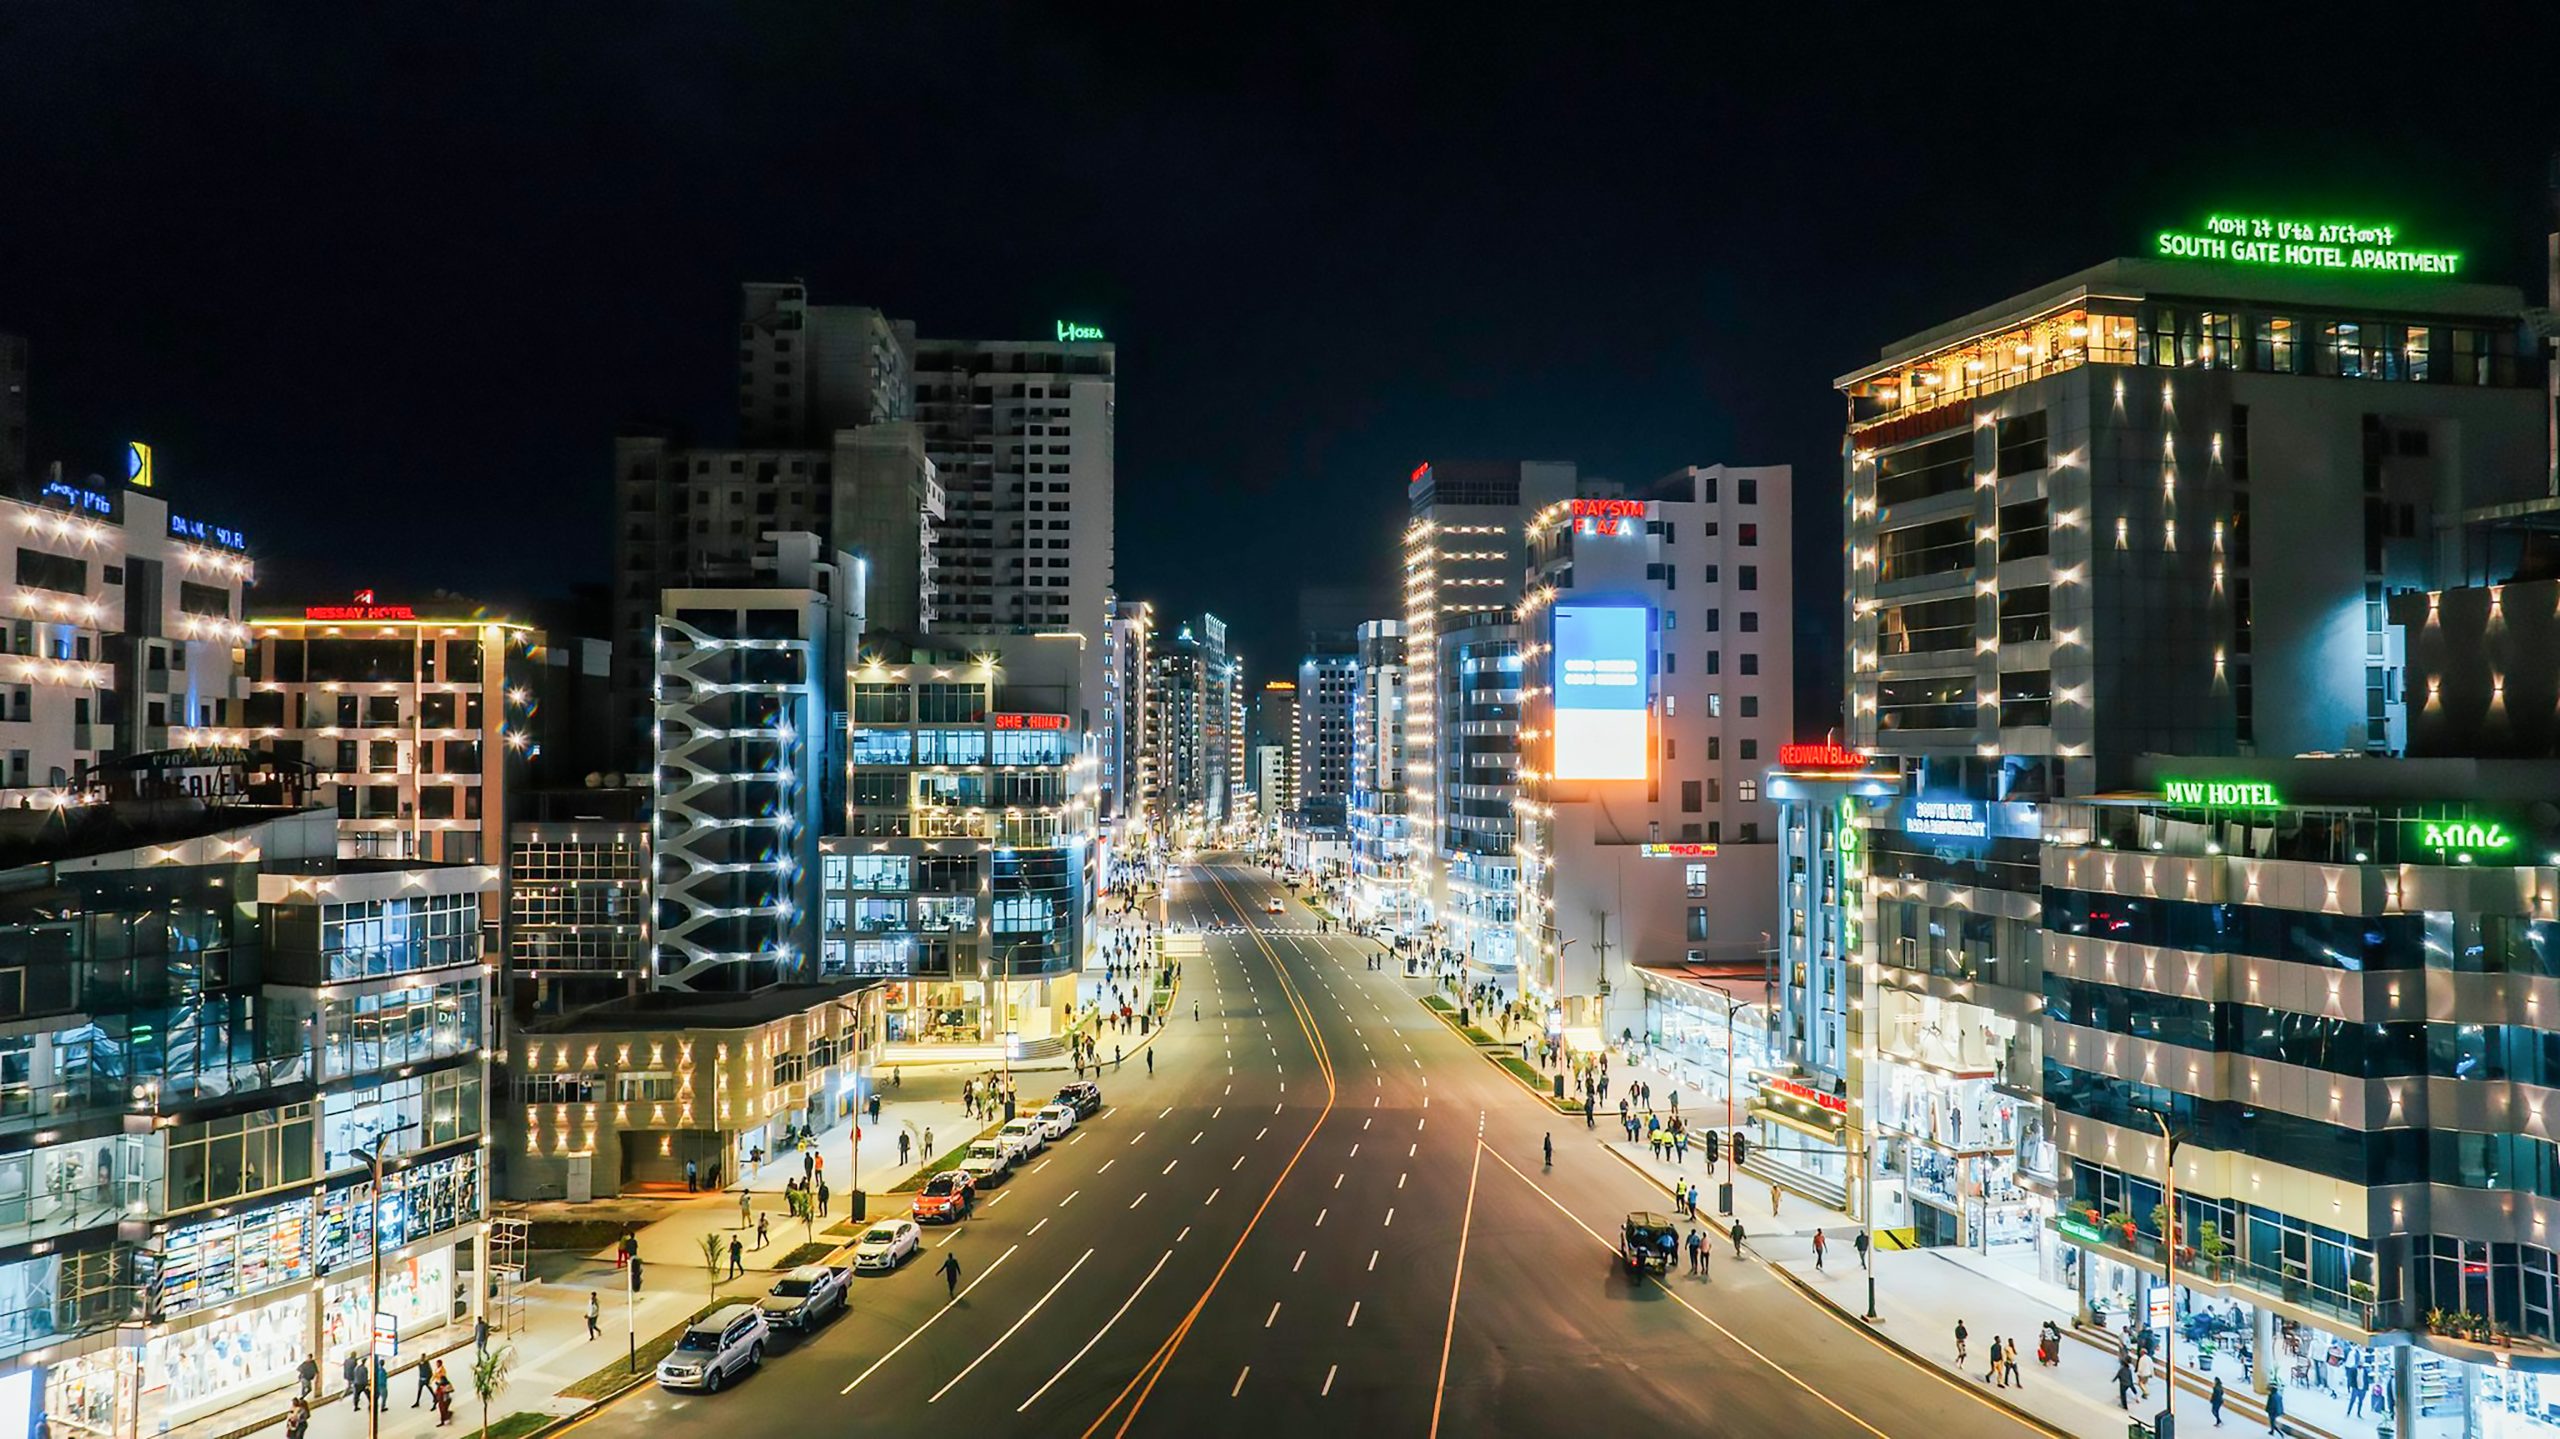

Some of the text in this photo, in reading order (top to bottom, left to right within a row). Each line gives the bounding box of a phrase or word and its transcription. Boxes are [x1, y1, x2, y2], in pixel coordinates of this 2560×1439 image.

[2159, 234, 2458, 273] SOUTH GATE HOTEL APARTMENT
[1057, 319, 1103, 342] HOSEA
[1573, 518, 1632, 536] PLAZA
[306, 607, 416, 620] MESSAY HOTEL
[1780, 745, 1829, 764] REDWAN
[2165, 782, 2279, 805] MW HOTEL
